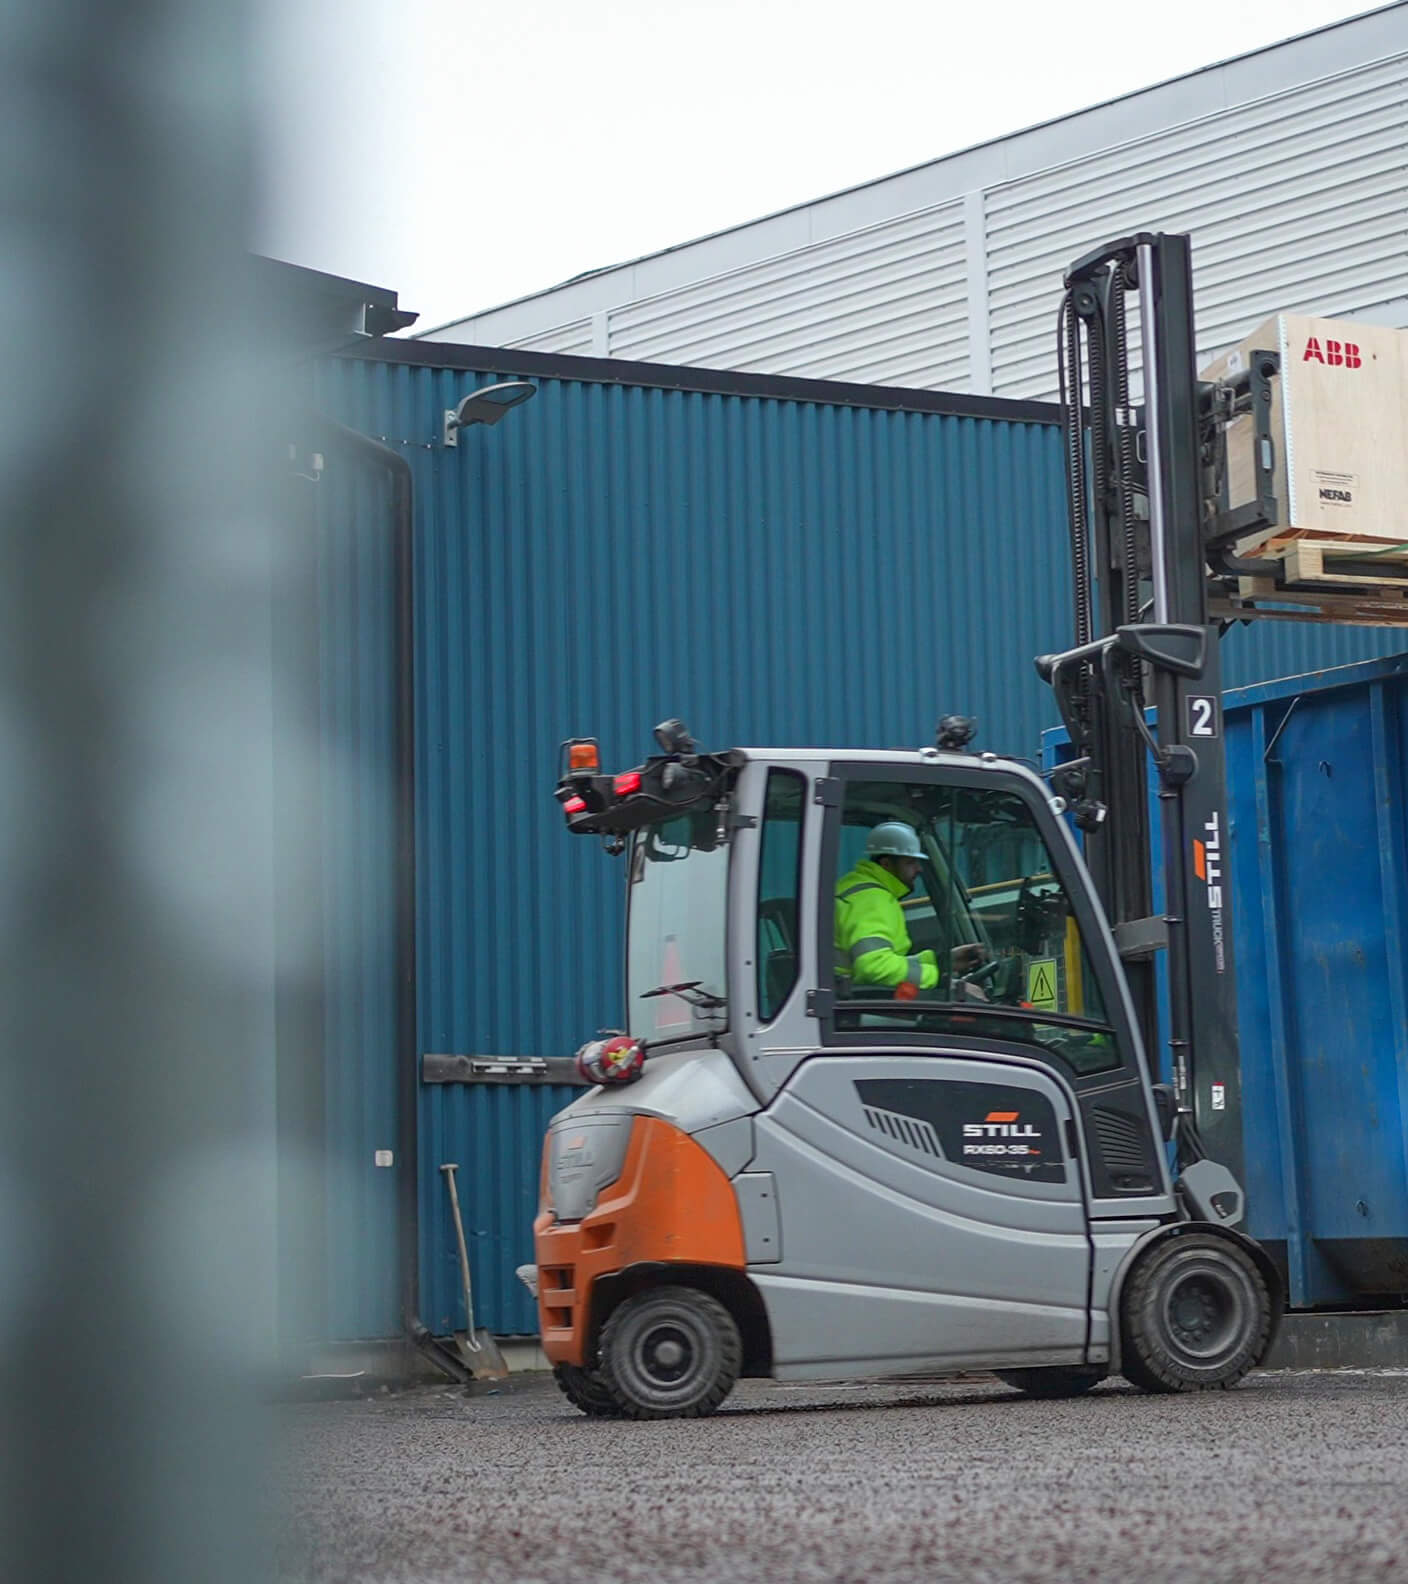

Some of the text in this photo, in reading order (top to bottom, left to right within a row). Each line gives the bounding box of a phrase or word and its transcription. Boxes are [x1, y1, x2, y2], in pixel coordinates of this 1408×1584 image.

[1303, 337, 1361, 368] ABB
[1319, 488, 1351, 502] NEFAB
[1192, 699, 1212, 735] 2
[1204, 811, 1222, 909] STILL
[962, 1124, 1041, 1137] STILL
